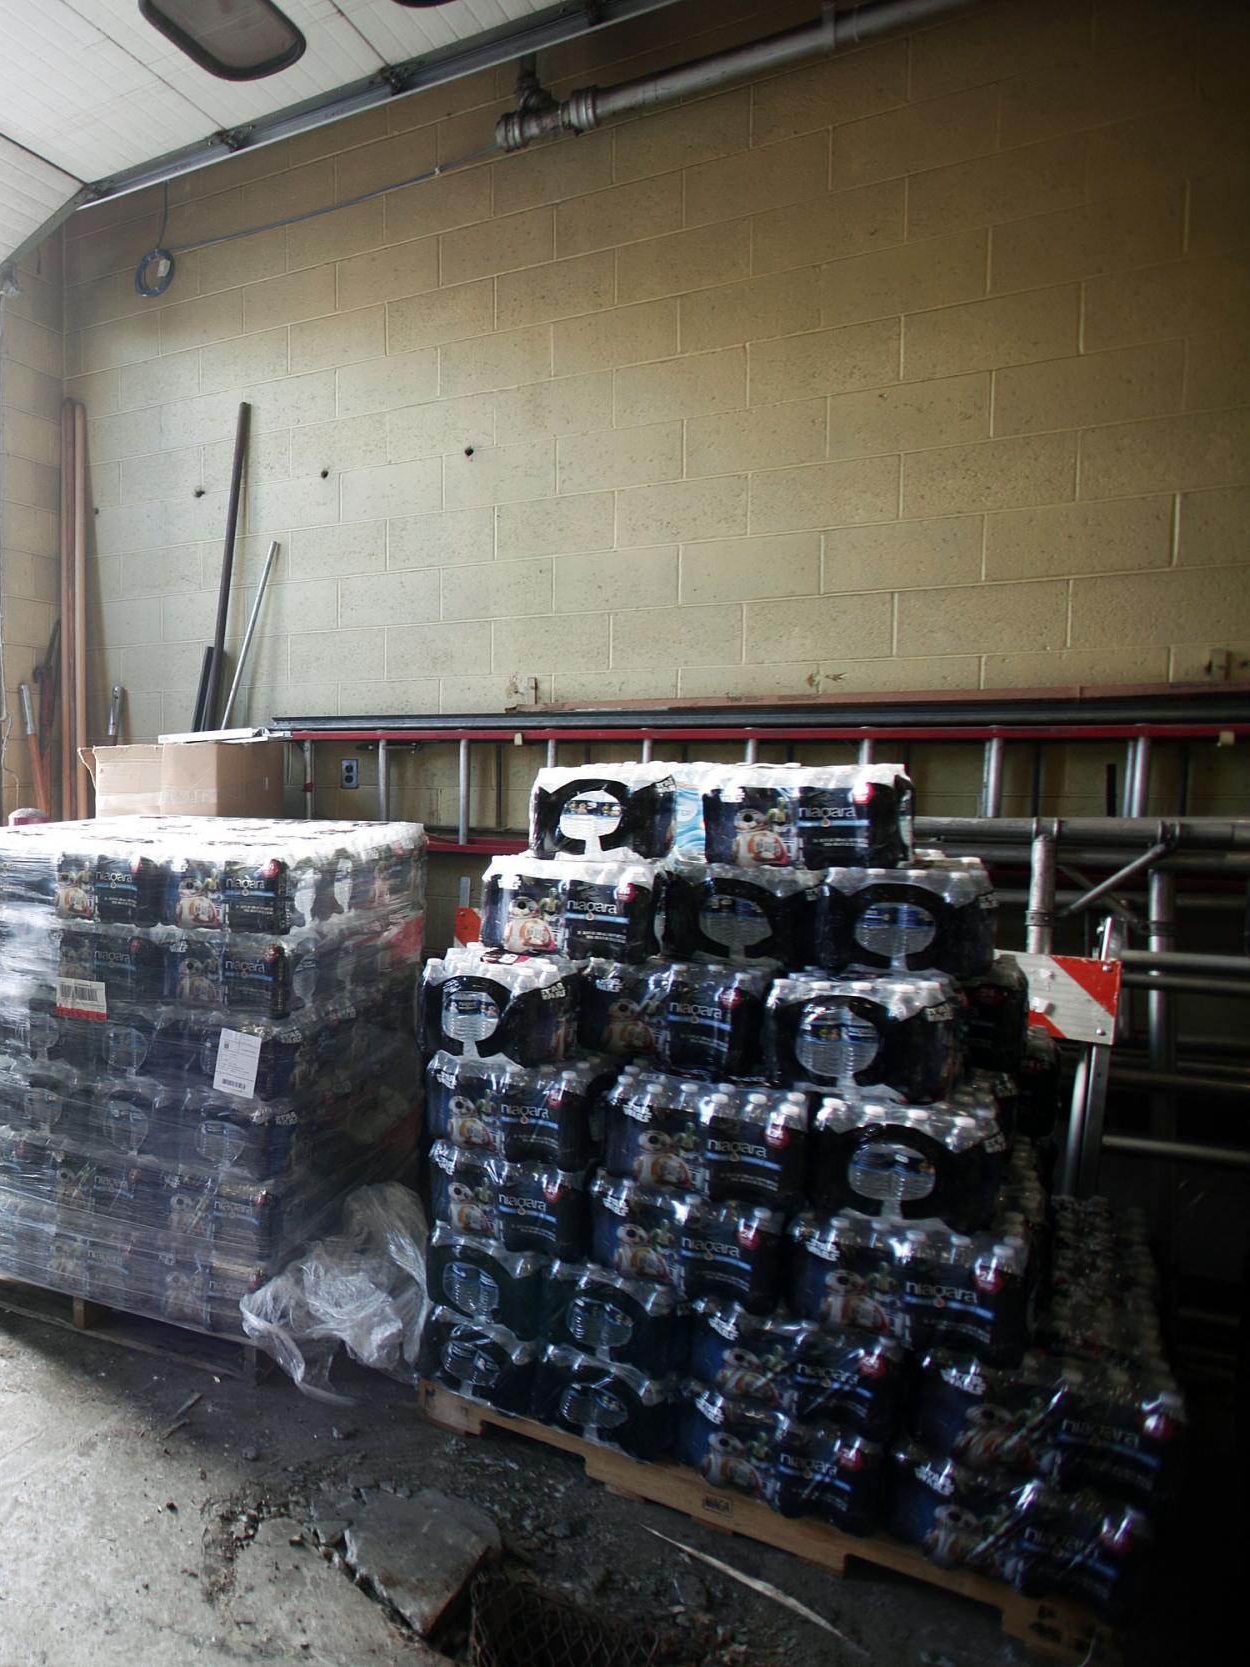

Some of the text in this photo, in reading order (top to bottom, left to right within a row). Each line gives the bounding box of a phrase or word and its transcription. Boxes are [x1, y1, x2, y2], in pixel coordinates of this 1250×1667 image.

[798, 806, 856, 823] niagara
[94, 870, 133, 887] niagara
[225, 877, 265, 894] niagara
[566, 899, 617, 919] niagara
[225, 961, 265, 976] niagara
[669, 1001, 722, 1022] niagara
[500, 1103, 549, 1123] niagara
[707, 1138, 767, 1160] niagara
[498, 1193, 547, 1213] niagara
[681, 1237, 741, 1259] niagara
[904, 1281, 977, 1305] niagara
